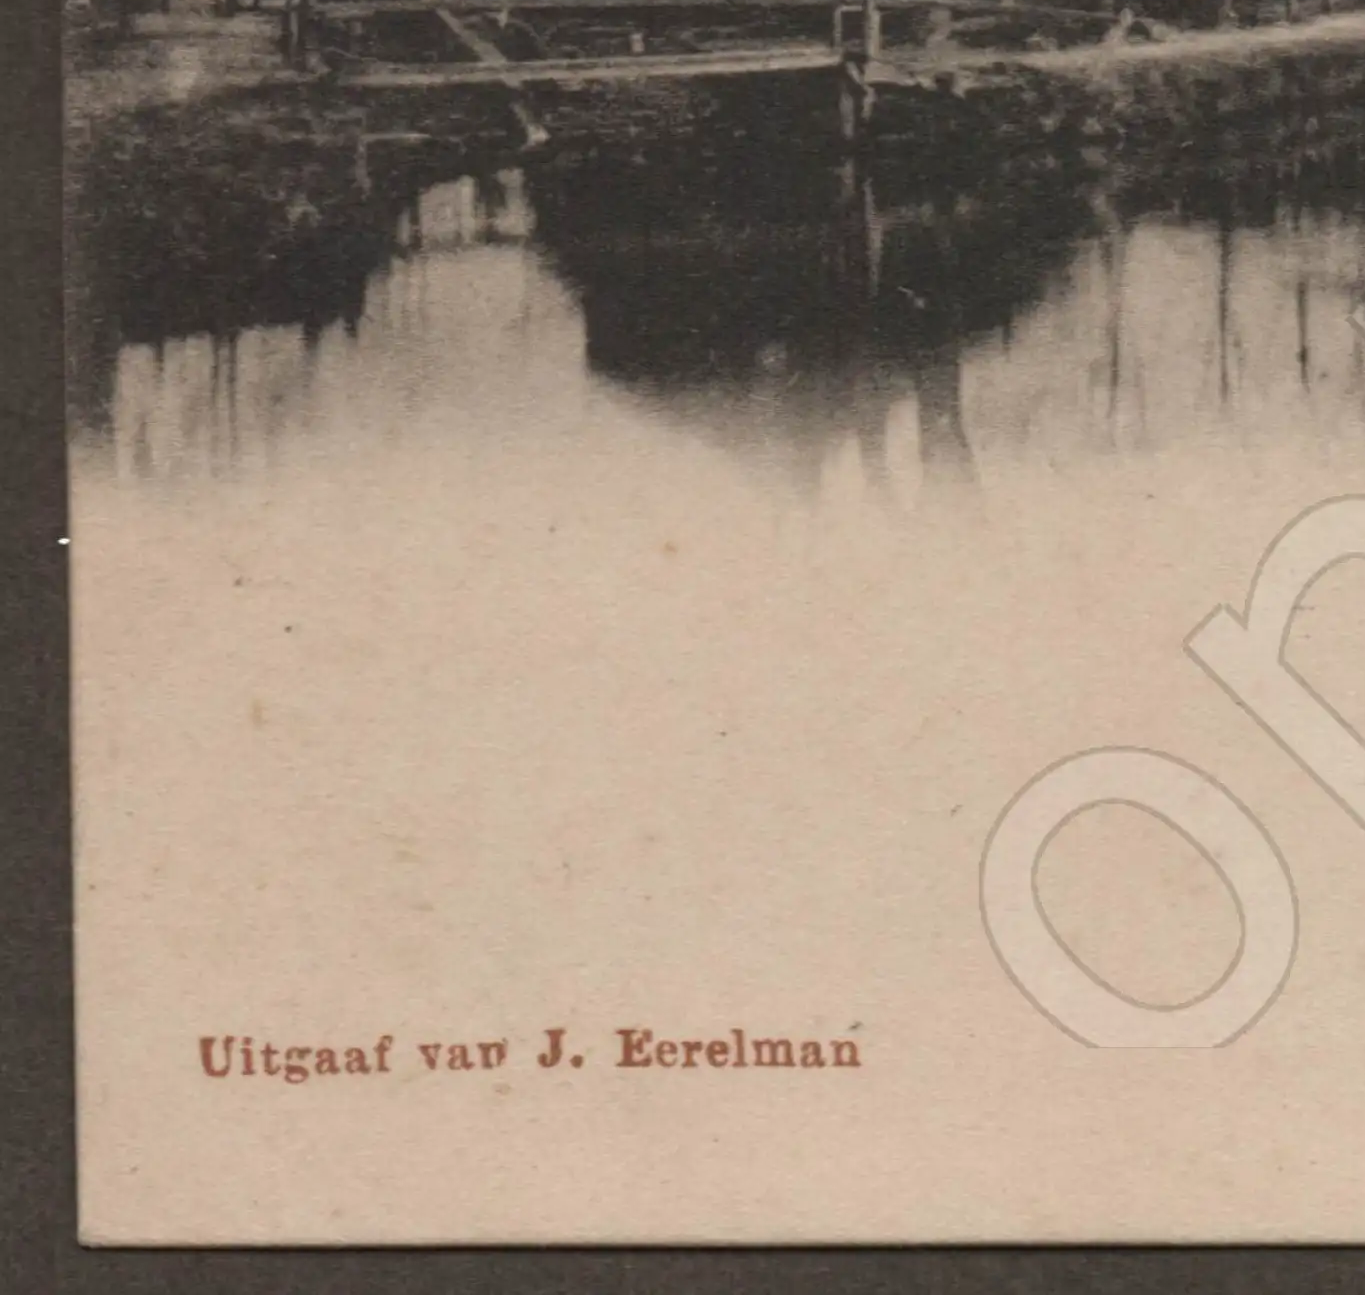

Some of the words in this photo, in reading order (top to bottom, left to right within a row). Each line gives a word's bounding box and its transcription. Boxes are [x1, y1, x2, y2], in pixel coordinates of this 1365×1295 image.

[200, 1035, 393, 1082] Uitgaaf
[419, 1039, 507, 1070] van
[536, 1028, 583, 1068] J.
[616, 1029, 861, 1068] Eerelman
